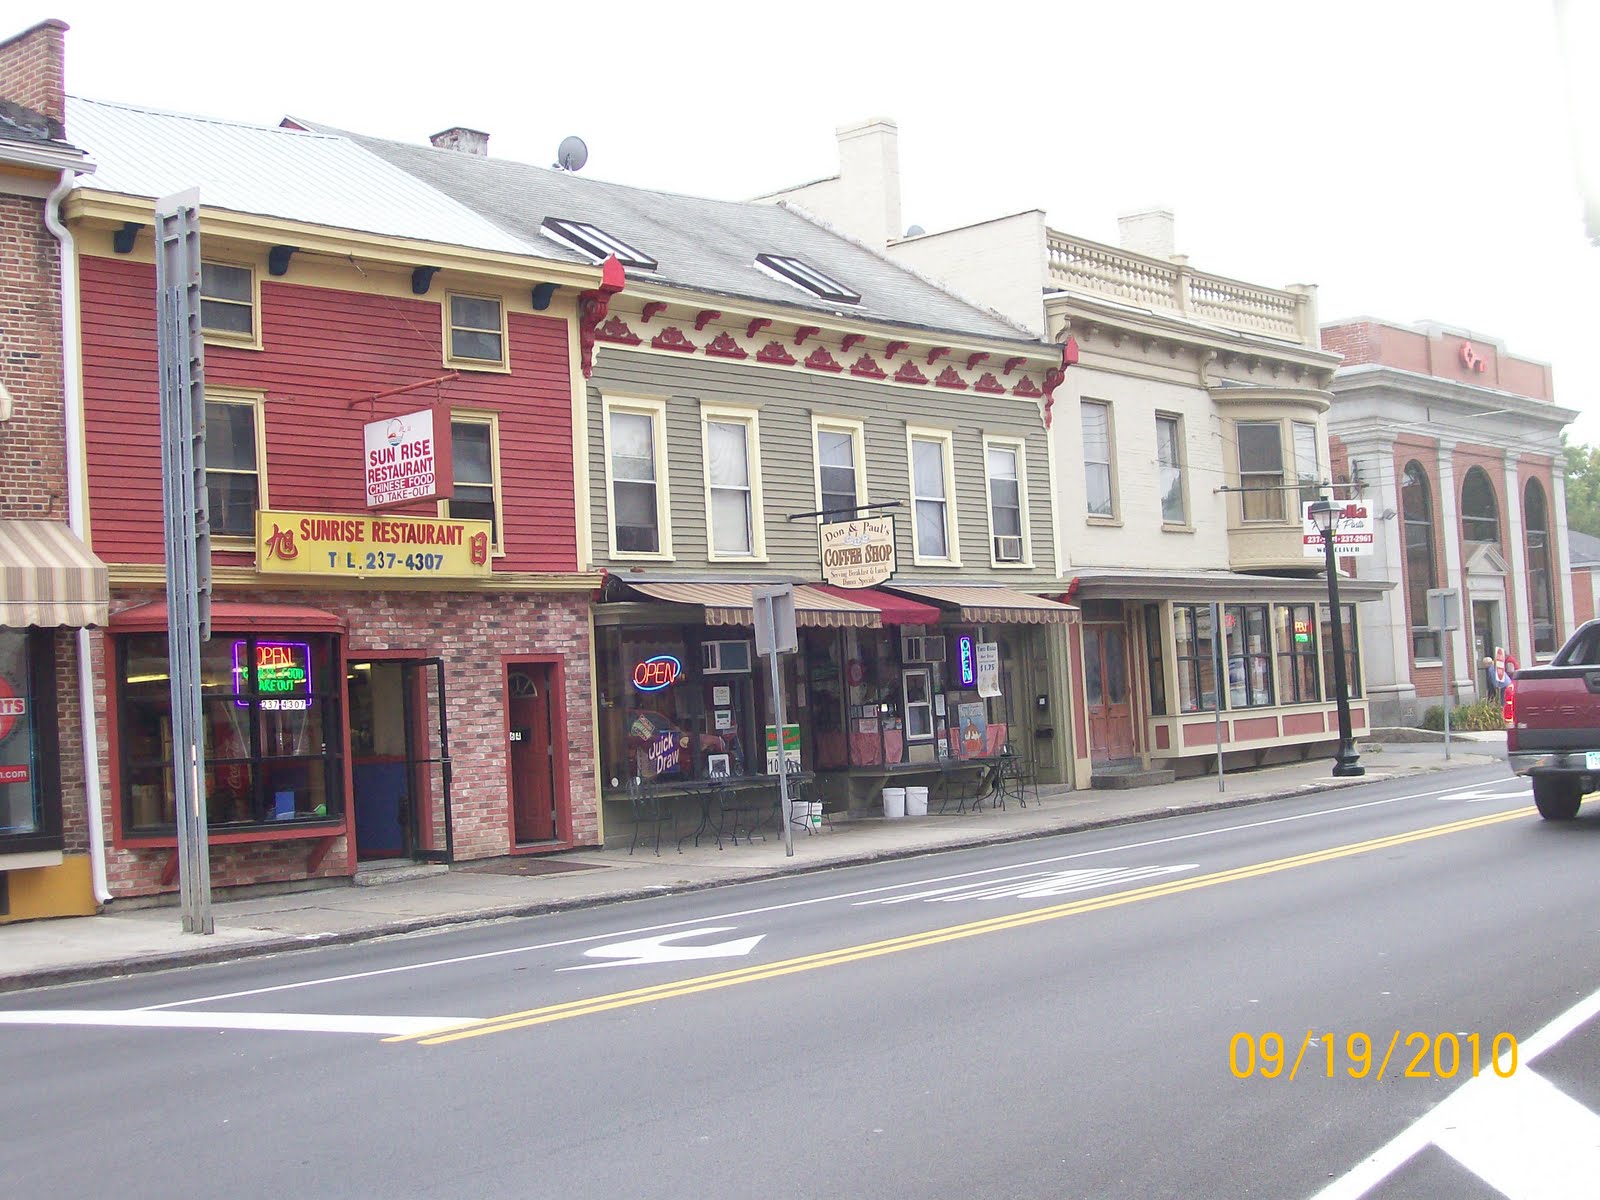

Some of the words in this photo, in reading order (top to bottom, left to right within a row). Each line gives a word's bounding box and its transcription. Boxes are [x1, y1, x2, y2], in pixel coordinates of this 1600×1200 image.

[370, 447, 395, 467] SUN
[401, 439, 430, 460] RISE
[368, 457, 433, 484] RESTAURANT
[369, 479, 406, 495] CHINESE
[408, 473, 434, 486] FOOD
[373, 494, 384, 504] TO
[388, 485, 430, 501] TAKE-OUT
[300, 518, 365, 543] SUNRISE
[372, 521, 464, 545] RESTAURANT
[825, 529, 845, 542] Don
[848, 523, 858, 533] &
[863, 521, 890, 535] Paul's
[824, 548, 862, 567] COFFEE
[865, 544, 892, 563] SHOP
[634, 662, 676, 684] OPEN
[962, 640, 971, 680] OPEN
[648, 731, 674, 760] Quick
[656, 748, 680, 775] Draw
